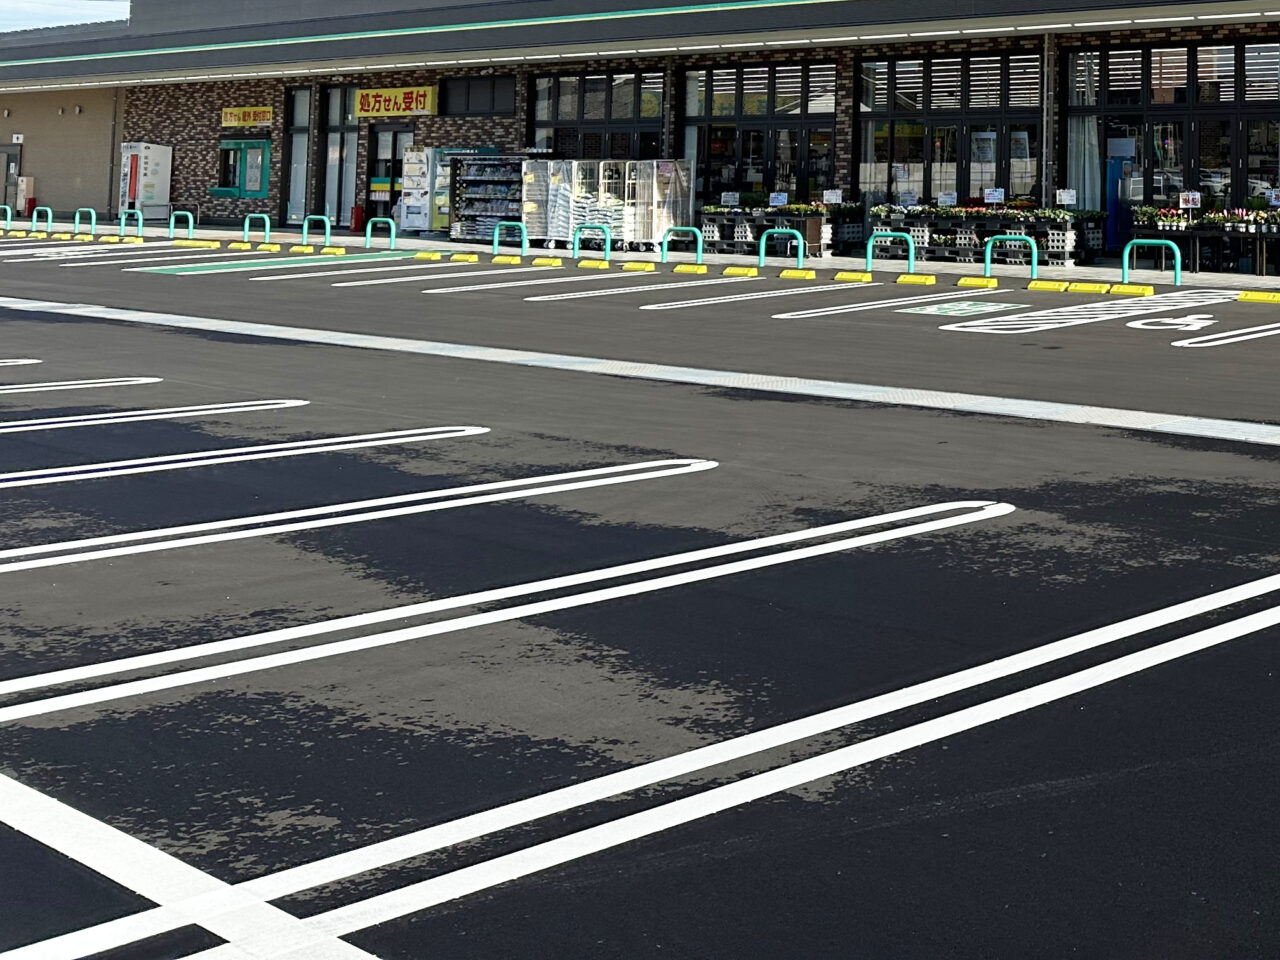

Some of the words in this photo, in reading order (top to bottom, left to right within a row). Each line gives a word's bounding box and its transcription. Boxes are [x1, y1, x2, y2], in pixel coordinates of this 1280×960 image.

[360, 90, 427, 112] 処方せん受付
